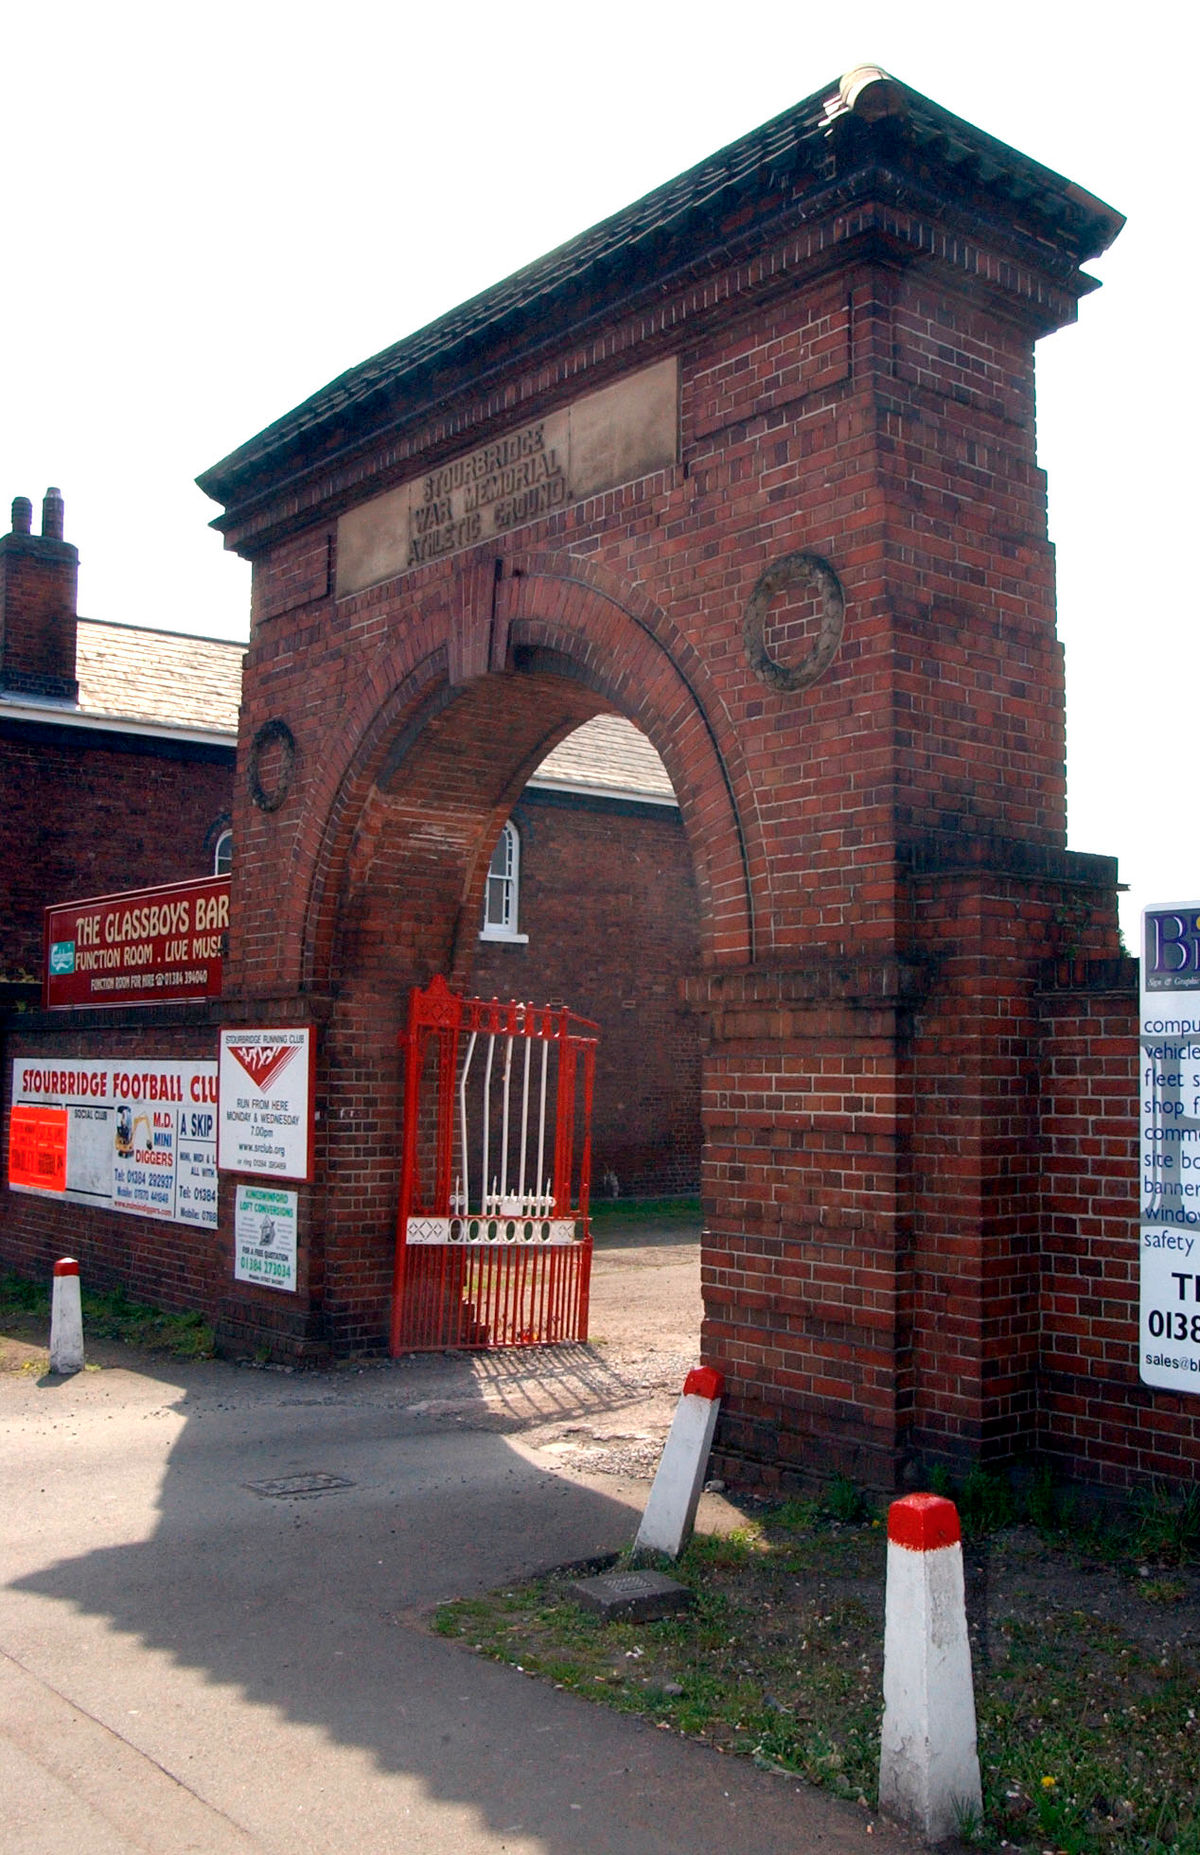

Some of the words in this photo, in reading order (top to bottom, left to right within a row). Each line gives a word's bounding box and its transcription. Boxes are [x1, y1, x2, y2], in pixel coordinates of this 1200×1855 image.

[415, 497, 453, 534] WAR
[464, 449, 562, 513] MEMORIAL
[407, 513, 482, 567] ATHLETIC
[76, 915, 101, 947] THE
[105, 901, 190, 943] GLASSBOYS
[195, 895, 230, 931] BAR
[75, 947, 120, 971] FUNCTION
[124, 944, 153, 966] ROOM
[165, 939, 188, 962] LIVE
[91, 977, 114, 991] FUNCTION
[115, 976, 130, 989] ROOM
[131, 975, 141, 988] FOR
[142, 973, 155, 987] HIRE
[225, 1034, 261, 1044] STOURBRIDGE
[263, 1034, 288, 1044] RUNNING
[289, 1034, 305, 1043] CLUB
[1145, 1041, 1200, 1060] vehicle
[22, 1069, 107, 1097] STOURBRIDGE
[113, 1072, 183, 1102] FOOTBALL
[1144, 1068, 1184, 1087] fleet
[237, 1098, 249, 1109] RUN
[251, 1099, 269, 1110] FROM
[271, 1100, 289, 1111] HERE
[1144, 1096, 1184, 1120] shop
[74, 1108, 93, 1120] SOCIAL
[94, 1109, 108, 1121] CLUB
[153, 1112, 174, 1129] M.D.
[226, 1111, 251, 1122] MONDAY
[254, 1112, 258, 1123] &
[260, 1114, 300, 1126] WEDNESDAY
[180, 1113, 187, 1135] A
[191, 1113, 213, 1137] SKIP
[250, 1126, 273, 1138] 7.00pm
[154, 1132, 172, 1147] MINI
[1144, 1126, 1200, 1142] comm
[135, 1150, 173, 1167] DIGGERS
[239, 1143, 286, 1158] www.srclub.org
[1144, 1150, 1174, 1168] site
[115, 1168, 125, 1180] Tel:
[127, 1169, 146, 1185] 01384
[190, 1166, 200, 1176] ALL
[202, 1168, 215, 1178] WITH
[179, 1185, 191, 1198] Tel:
[193, 1187, 216, 1202] 01384
[239, 1201, 253, 1212] LOFT
[254, 1203, 294, 1218] CONVERSIONS
[1144, 1230, 1194, 1257] safety
[254, 1248, 264, 1257] FREE
[264, 1250, 289, 1262] QUOTATION
[240, 1256, 262, 1272] 01384
